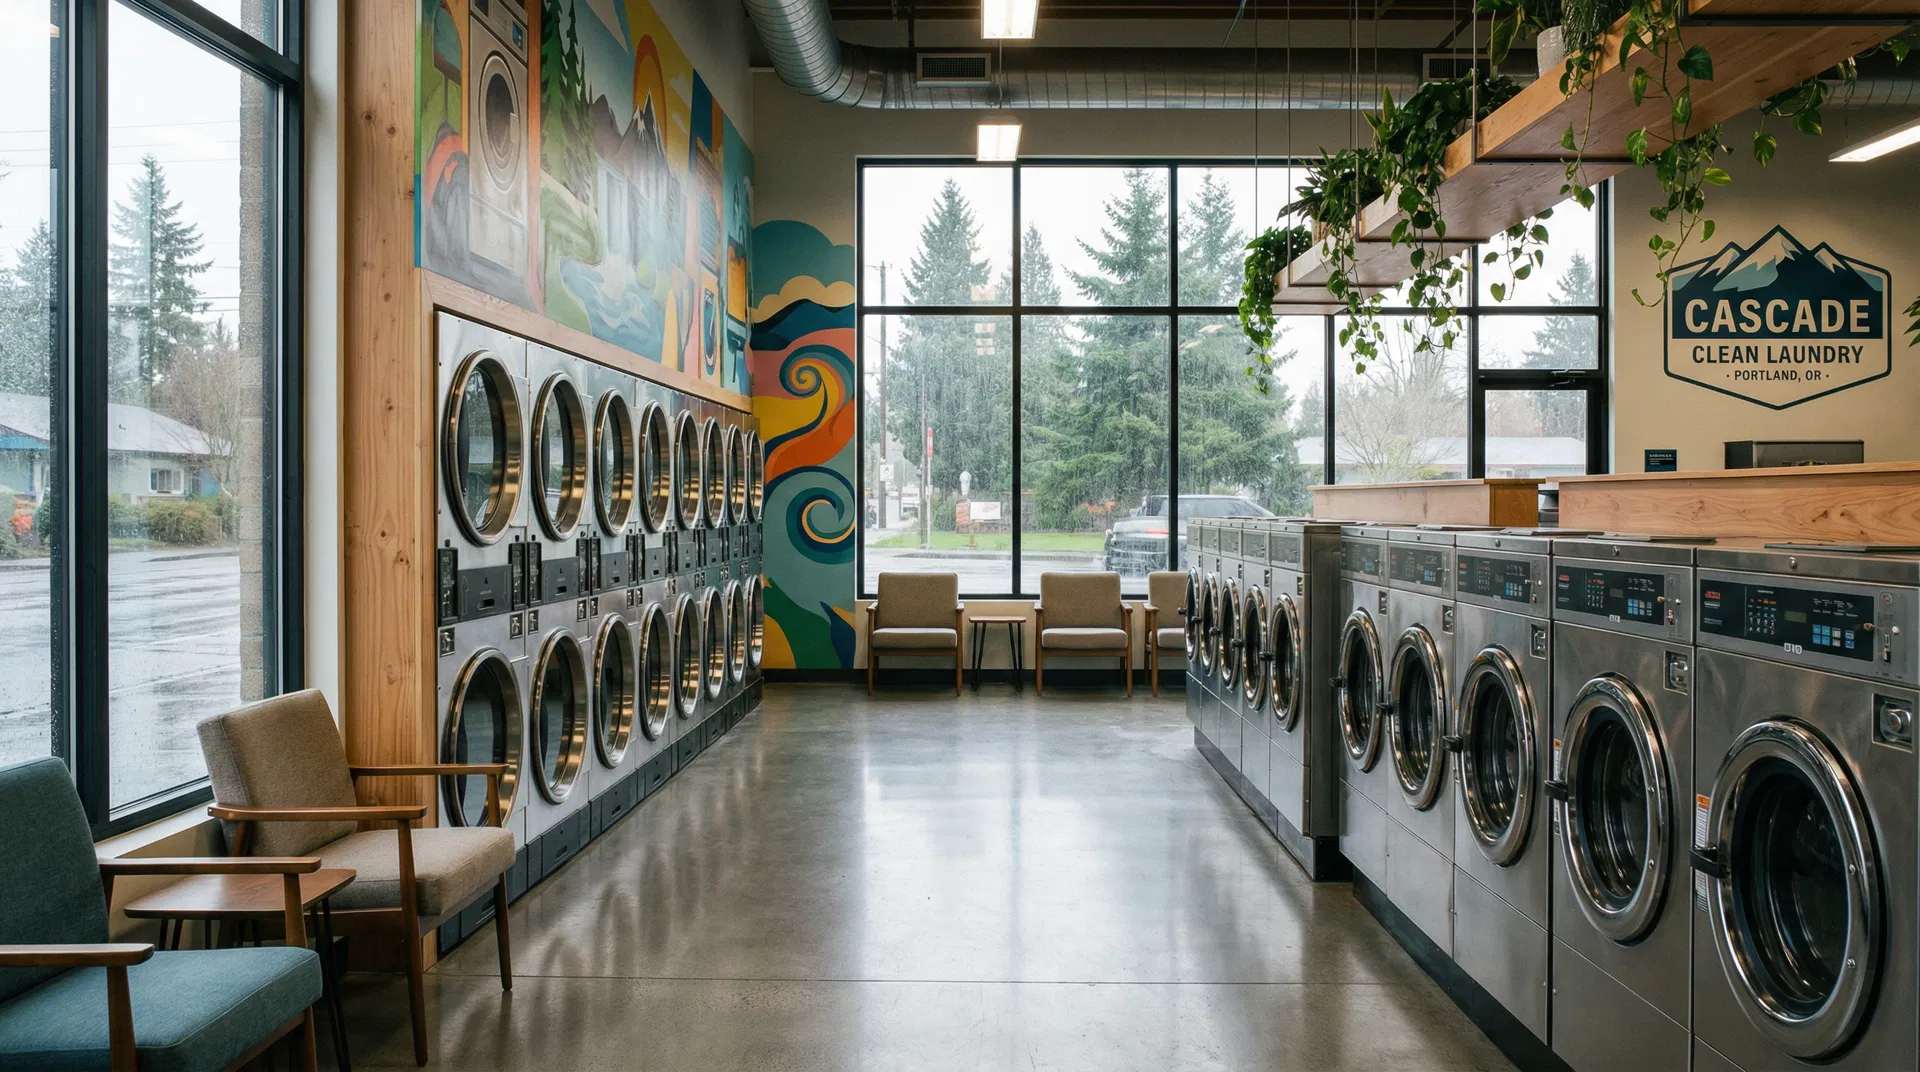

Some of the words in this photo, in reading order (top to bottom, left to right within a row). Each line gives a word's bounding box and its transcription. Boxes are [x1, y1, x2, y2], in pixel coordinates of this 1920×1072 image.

[1684, 299, 1870, 333] CASCADE
[1692, 345, 1759, 364] CLEAN
[1767, 345, 1864, 364] LAUNDRY
[1734, 369, 1801, 383] PORTLAND,
[1805, 370, 1822, 382] OR
